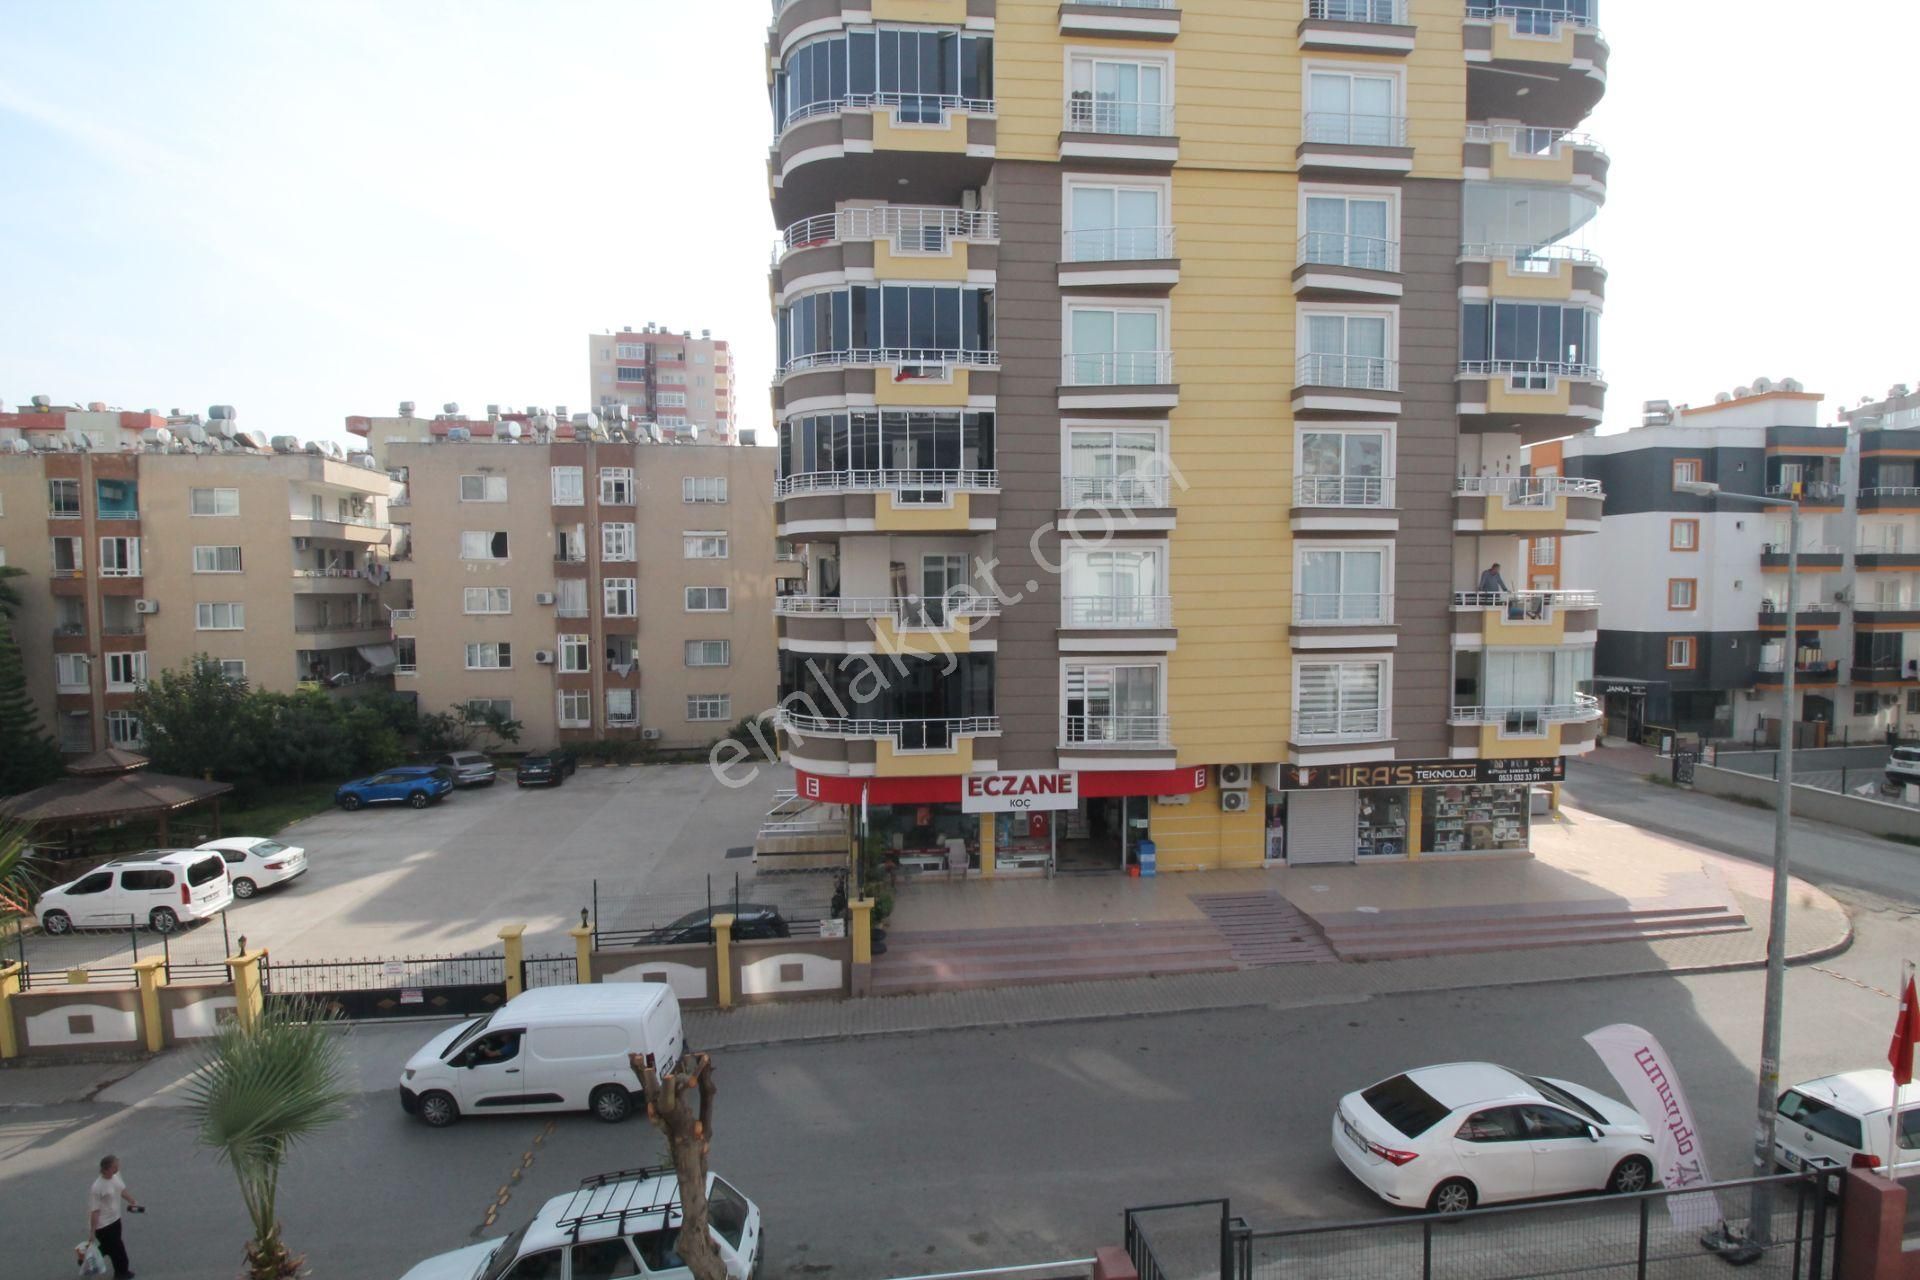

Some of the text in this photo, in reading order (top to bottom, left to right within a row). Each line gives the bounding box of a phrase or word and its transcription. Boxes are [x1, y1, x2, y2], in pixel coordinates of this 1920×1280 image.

[1197, 770, 1205, 787] E
[1416, 768, 1476, 779] TEKNOLOJİ
[808, 779, 817, 796] E
[968, 774, 1072, 796] ECZANE
[1009, 799, 1031, 809] KOÇ
[1634, 1046, 1694, 1156] optimum
